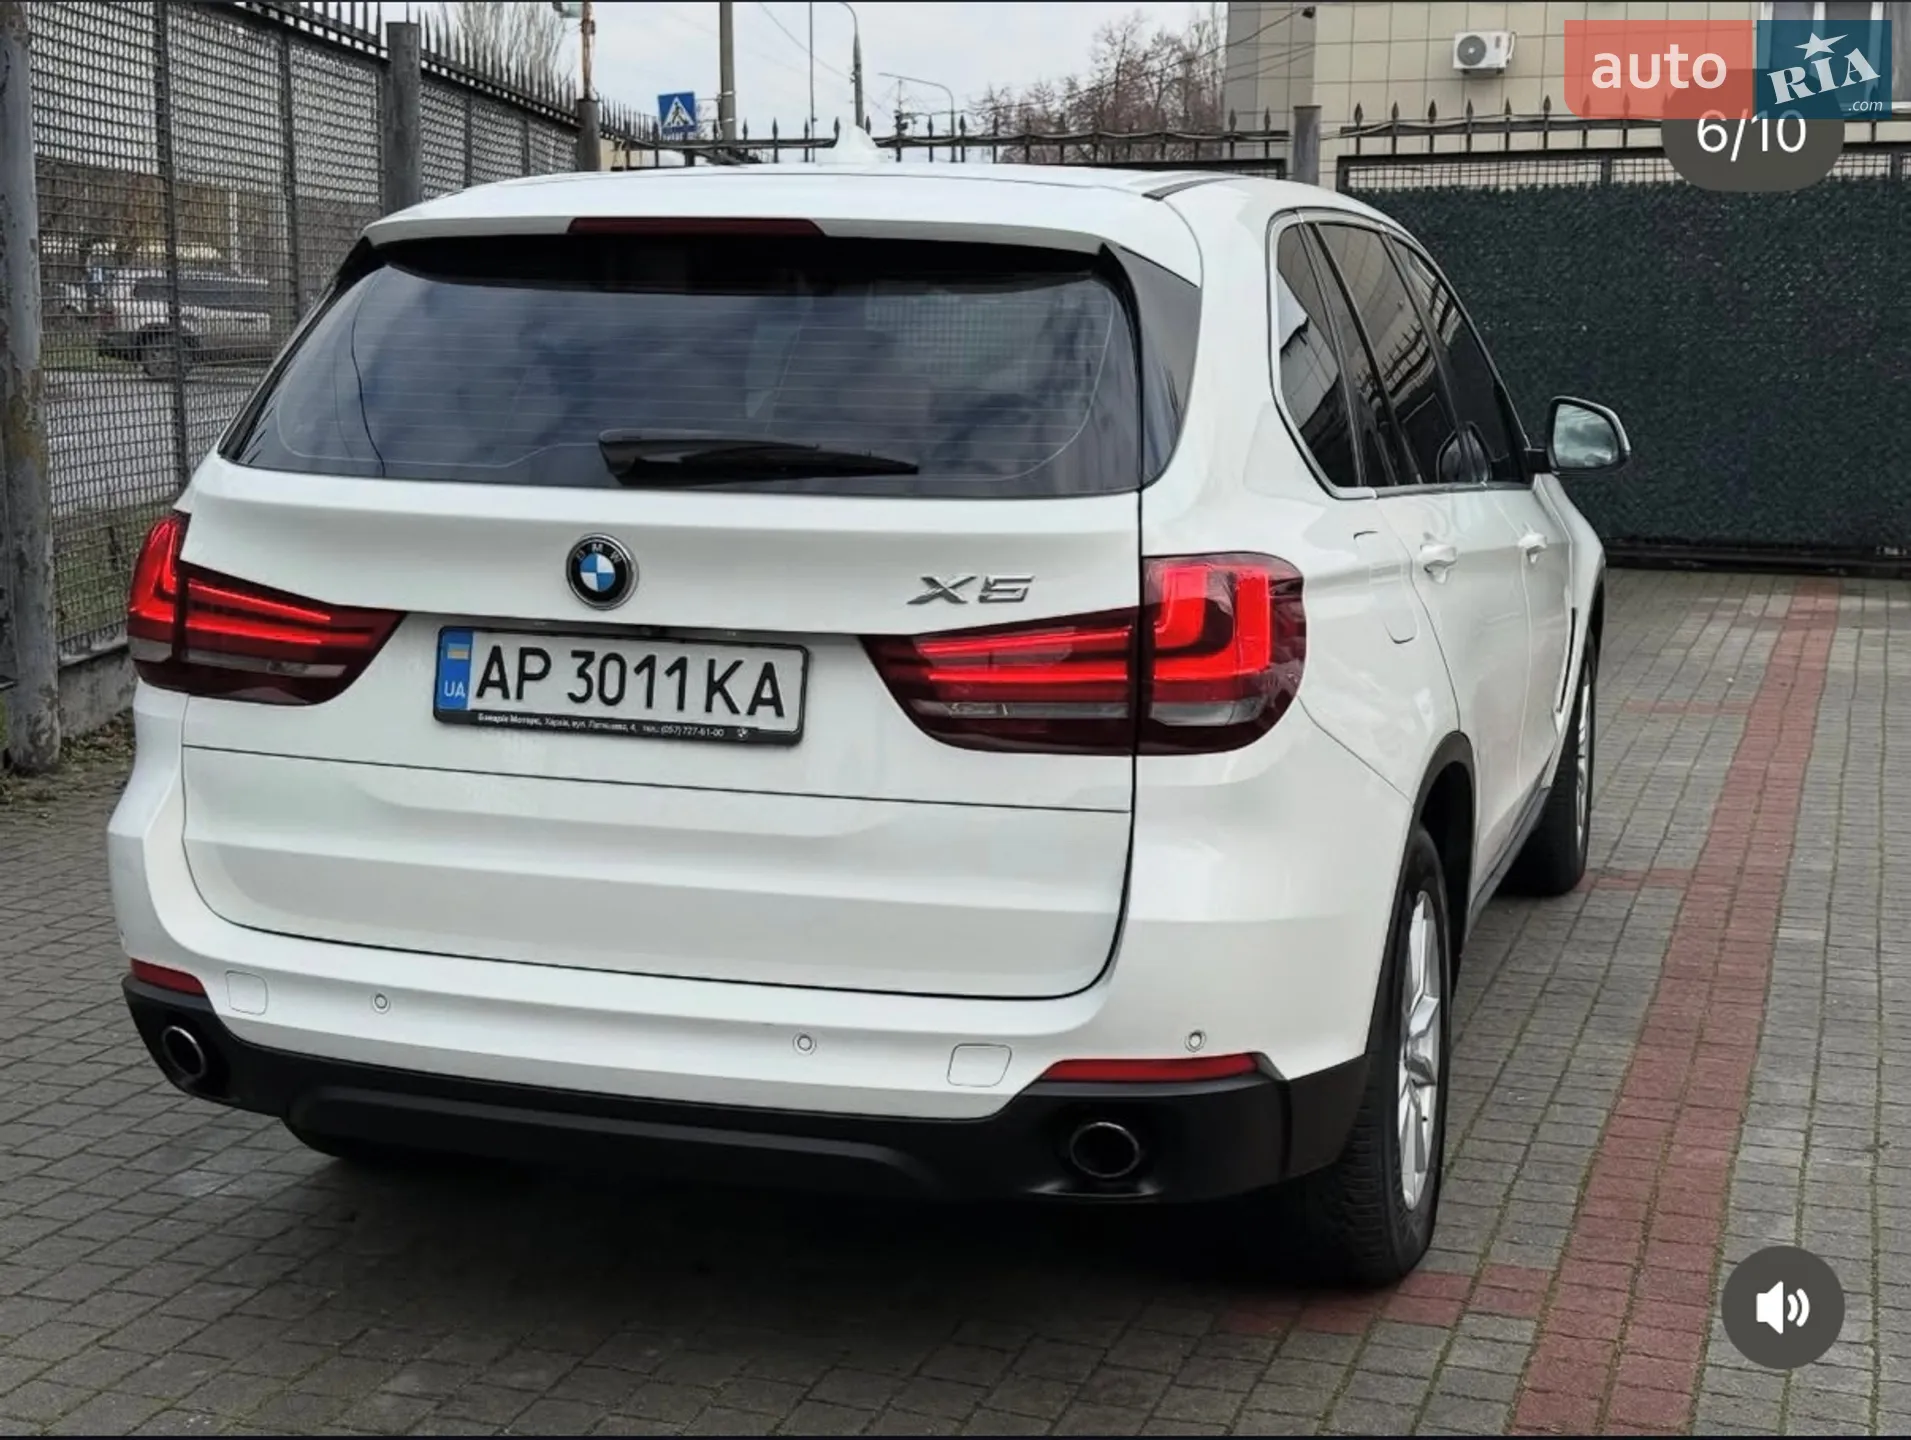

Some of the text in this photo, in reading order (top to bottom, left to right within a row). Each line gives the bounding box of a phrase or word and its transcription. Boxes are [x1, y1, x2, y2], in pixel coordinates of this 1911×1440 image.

[906, 574, 1035, 605] X5
[444, 681, 466, 698] UA
[476, 645, 786, 718] AP 3011 KA
